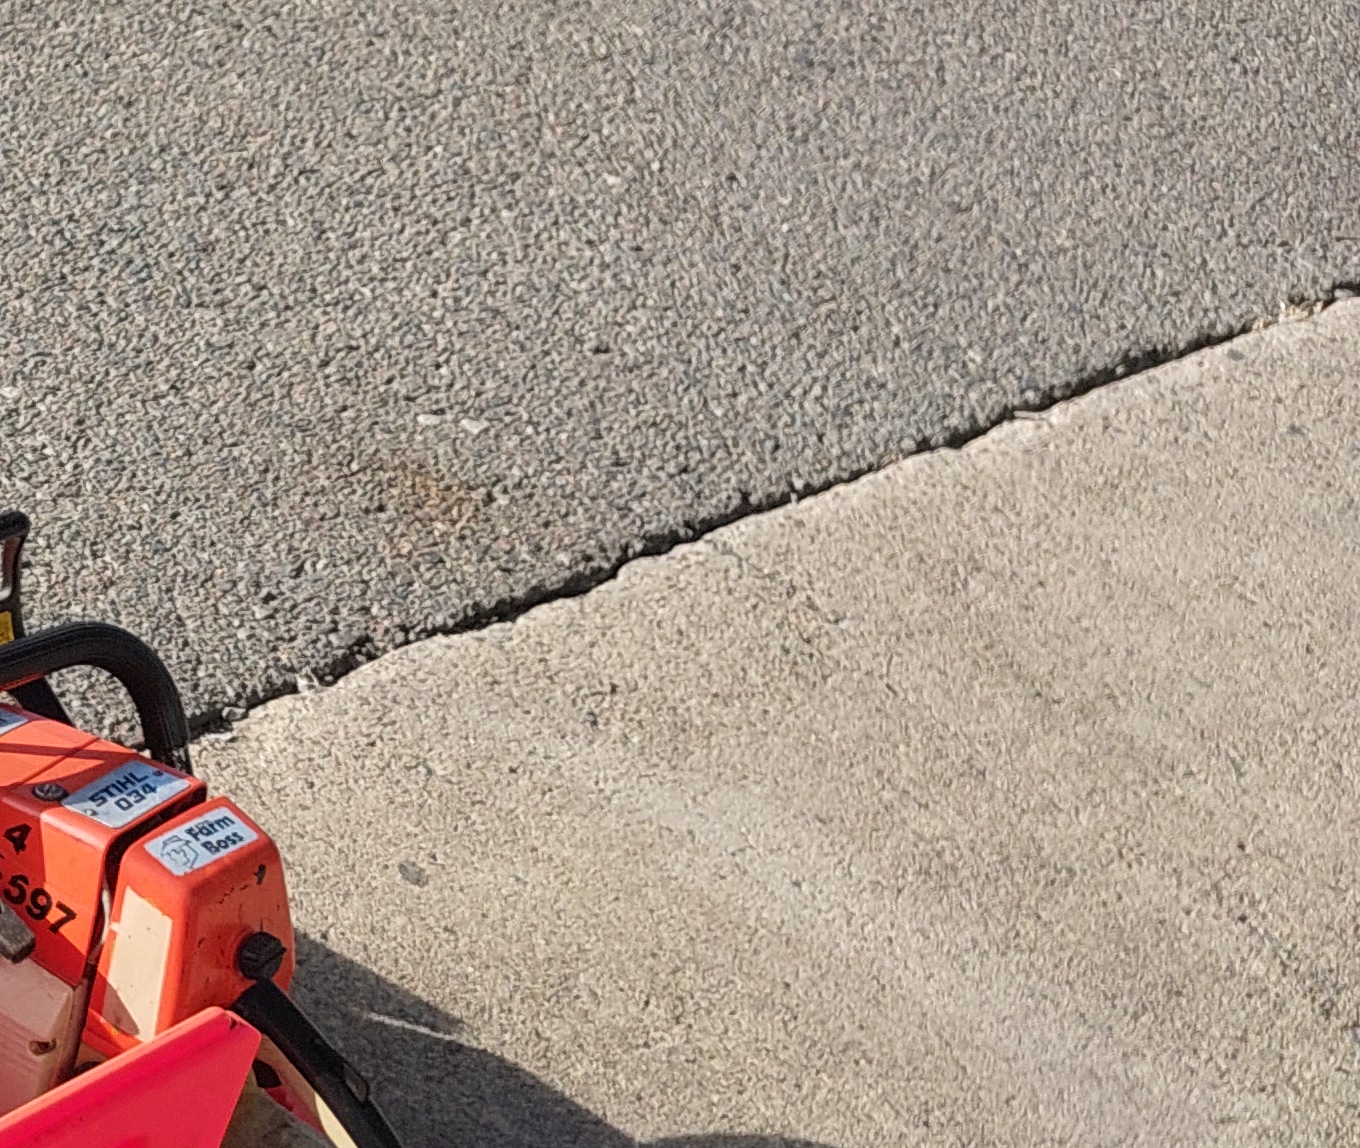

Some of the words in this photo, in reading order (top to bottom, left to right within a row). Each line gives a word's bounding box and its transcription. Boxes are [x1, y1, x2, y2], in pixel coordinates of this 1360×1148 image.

[89, 771, 147, 808] STIHL
[114, 784, 158, 812] 034
[4, 823, 32, 853] 4
[187, 815, 237, 841] Farm
[201, 833, 246, 856] Boss
